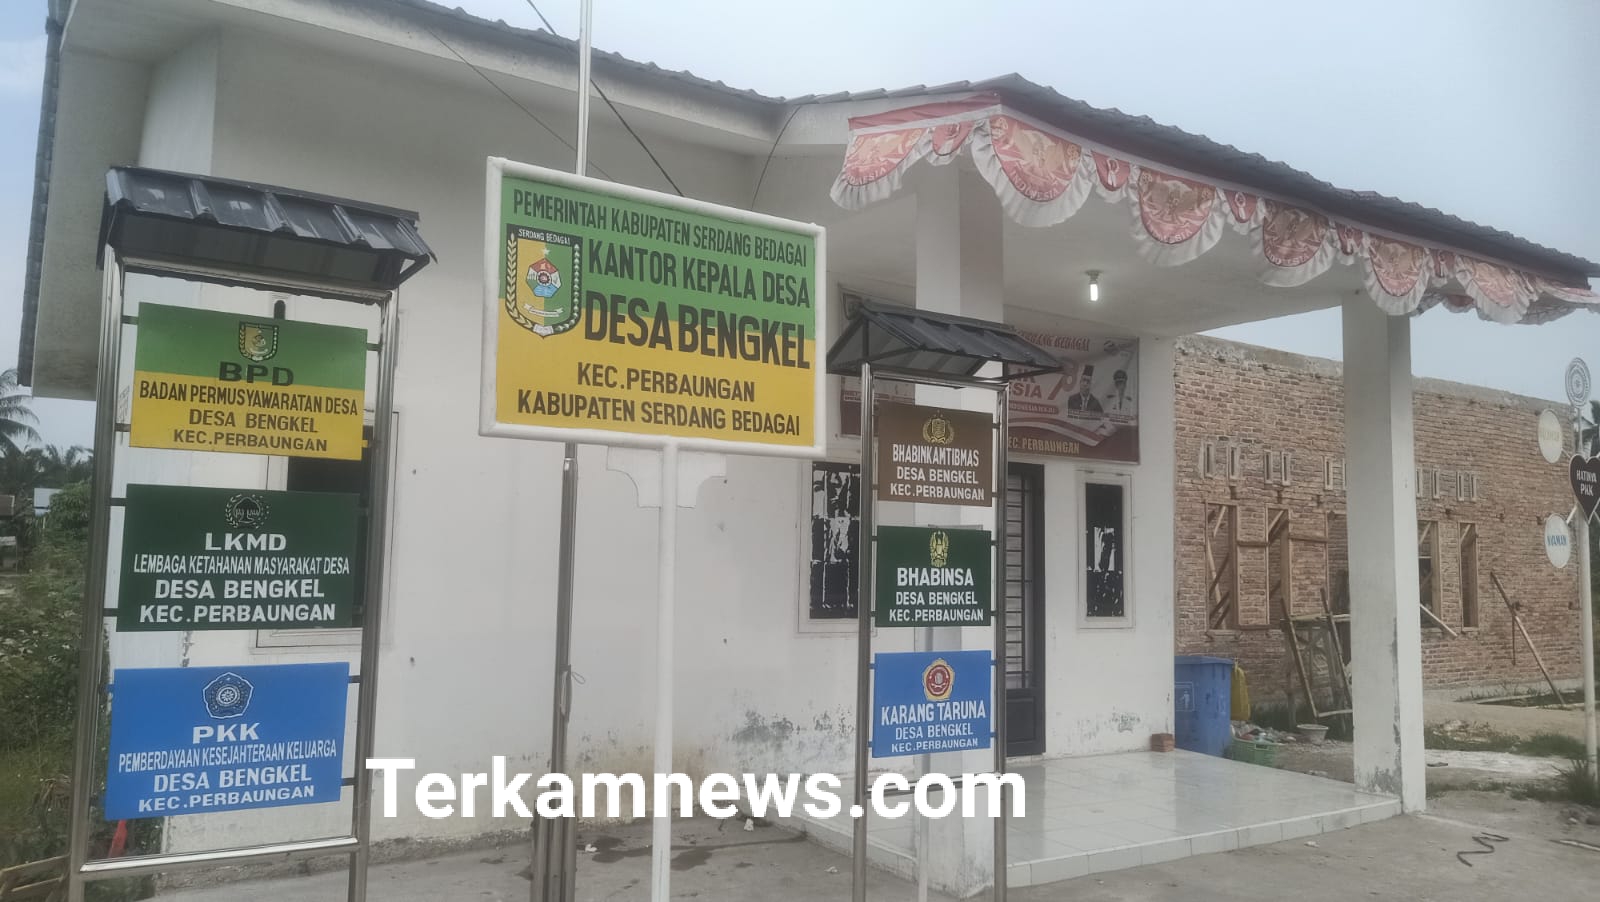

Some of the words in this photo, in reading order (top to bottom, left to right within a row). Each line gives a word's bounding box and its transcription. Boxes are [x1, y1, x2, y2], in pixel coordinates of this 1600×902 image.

[513, 188, 606, 230] PEMERINTAH
[611, 207, 689, 246] KABUPATEN
[692, 226, 750, 257] SERDANG
[754, 240, 806, 268] BEDAGAI
[518, 228, 544, 241] SERDANG
[546, 232, 570, 245] BEDAGAI
[588, 238, 676, 288] KANTOR
[683, 256, 756, 300] KEPALA
[762, 270, 810, 308] DESA
[584, 290, 672, 350] DESA
[678, 304, 810, 370] BENGKEL
[218, 362, 294, 386] BPD
[140, 380, 187, 402] BADAN
[190, 386, 322, 414] PERMUSYAWARATAN
[326, 396, 358, 416] DESA
[189, 408, 236, 428] DESA
[246, 414, 318, 433] BENGKEL
[518, 389, 636, 422] KABUPATEN
[640, 402, 726, 430] SERDANG
[732, 410, 800, 436] BEDAGAI
[892, 444, 980, 467] BHABINKAMTIBMAS
[1022, 437, 1080, 454] PERBAUNGAN
[896, 466, 926, 482] DESA
[930, 468, 978, 484] BENGKEL
[1580, 483, 1594, 496] PKK
[206, 532, 286, 551] LKMD
[134, 554, 186, 574] LEMBAGA
[189, 556, 250, 574] KETAHANAN
[254, 556, 322, 575] MASYARAKAT
[323, 557, 350, 574] DESA
[897, 568, 974, 586] BHABINSA
[155, 580, 215, 600] DESA
[224, 578, 324, 599] BENGKEL
[896, 592, 925, 605] DESA
[928, 592, 978, 605] BENGKEL
[881, 703, 934, 726] KARANG
[936, 700, 986, 721] TARUNA
[192, 722, 260, 744] PKK
[896, 727, 924, 740] DESA
[928, 723, 974, 738] BENGKEL
[118, 750, 200, 773] PEMBERDAYAAN
[202, 743, 285, 767] KESEJAHTERAAN
[287, 740, 336, 760] KELUARGA
[154, 773, 210, 793] DESA
[219, 764, 312, 788] BENGKEL
